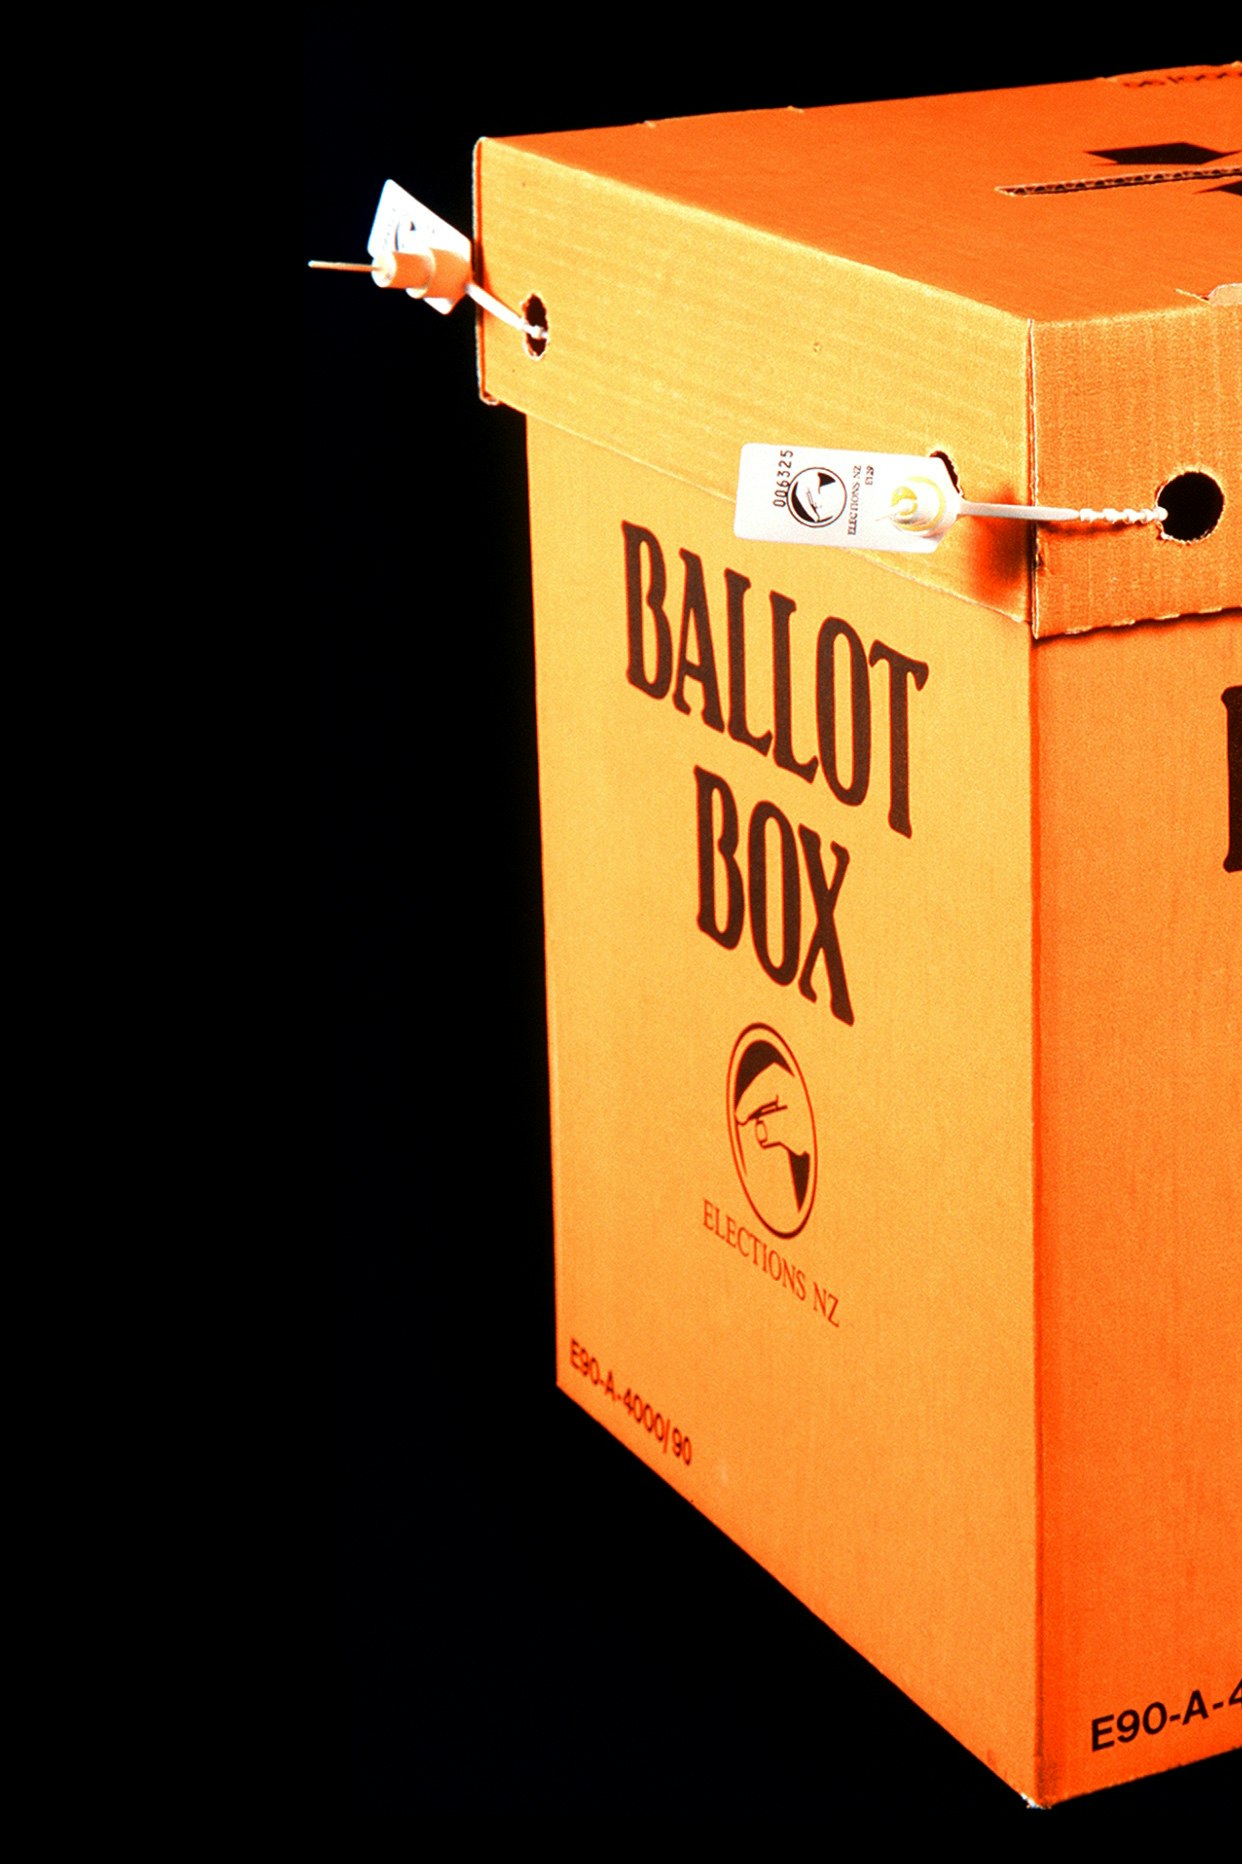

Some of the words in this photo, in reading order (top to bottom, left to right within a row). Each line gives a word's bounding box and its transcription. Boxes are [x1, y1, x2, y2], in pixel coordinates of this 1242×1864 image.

[772, 449, 794, 508] 006325
[847, 481, 861, 536] ELECTIONS
[852, 465, 862, 479] NZ
[620, 520, 930, 839] BALLOT
[693, 765, 855, 1027] BOX
[702, 1197, 807, 1302] ELECTIONS
[812, 1280, 840, 1328] NZ
